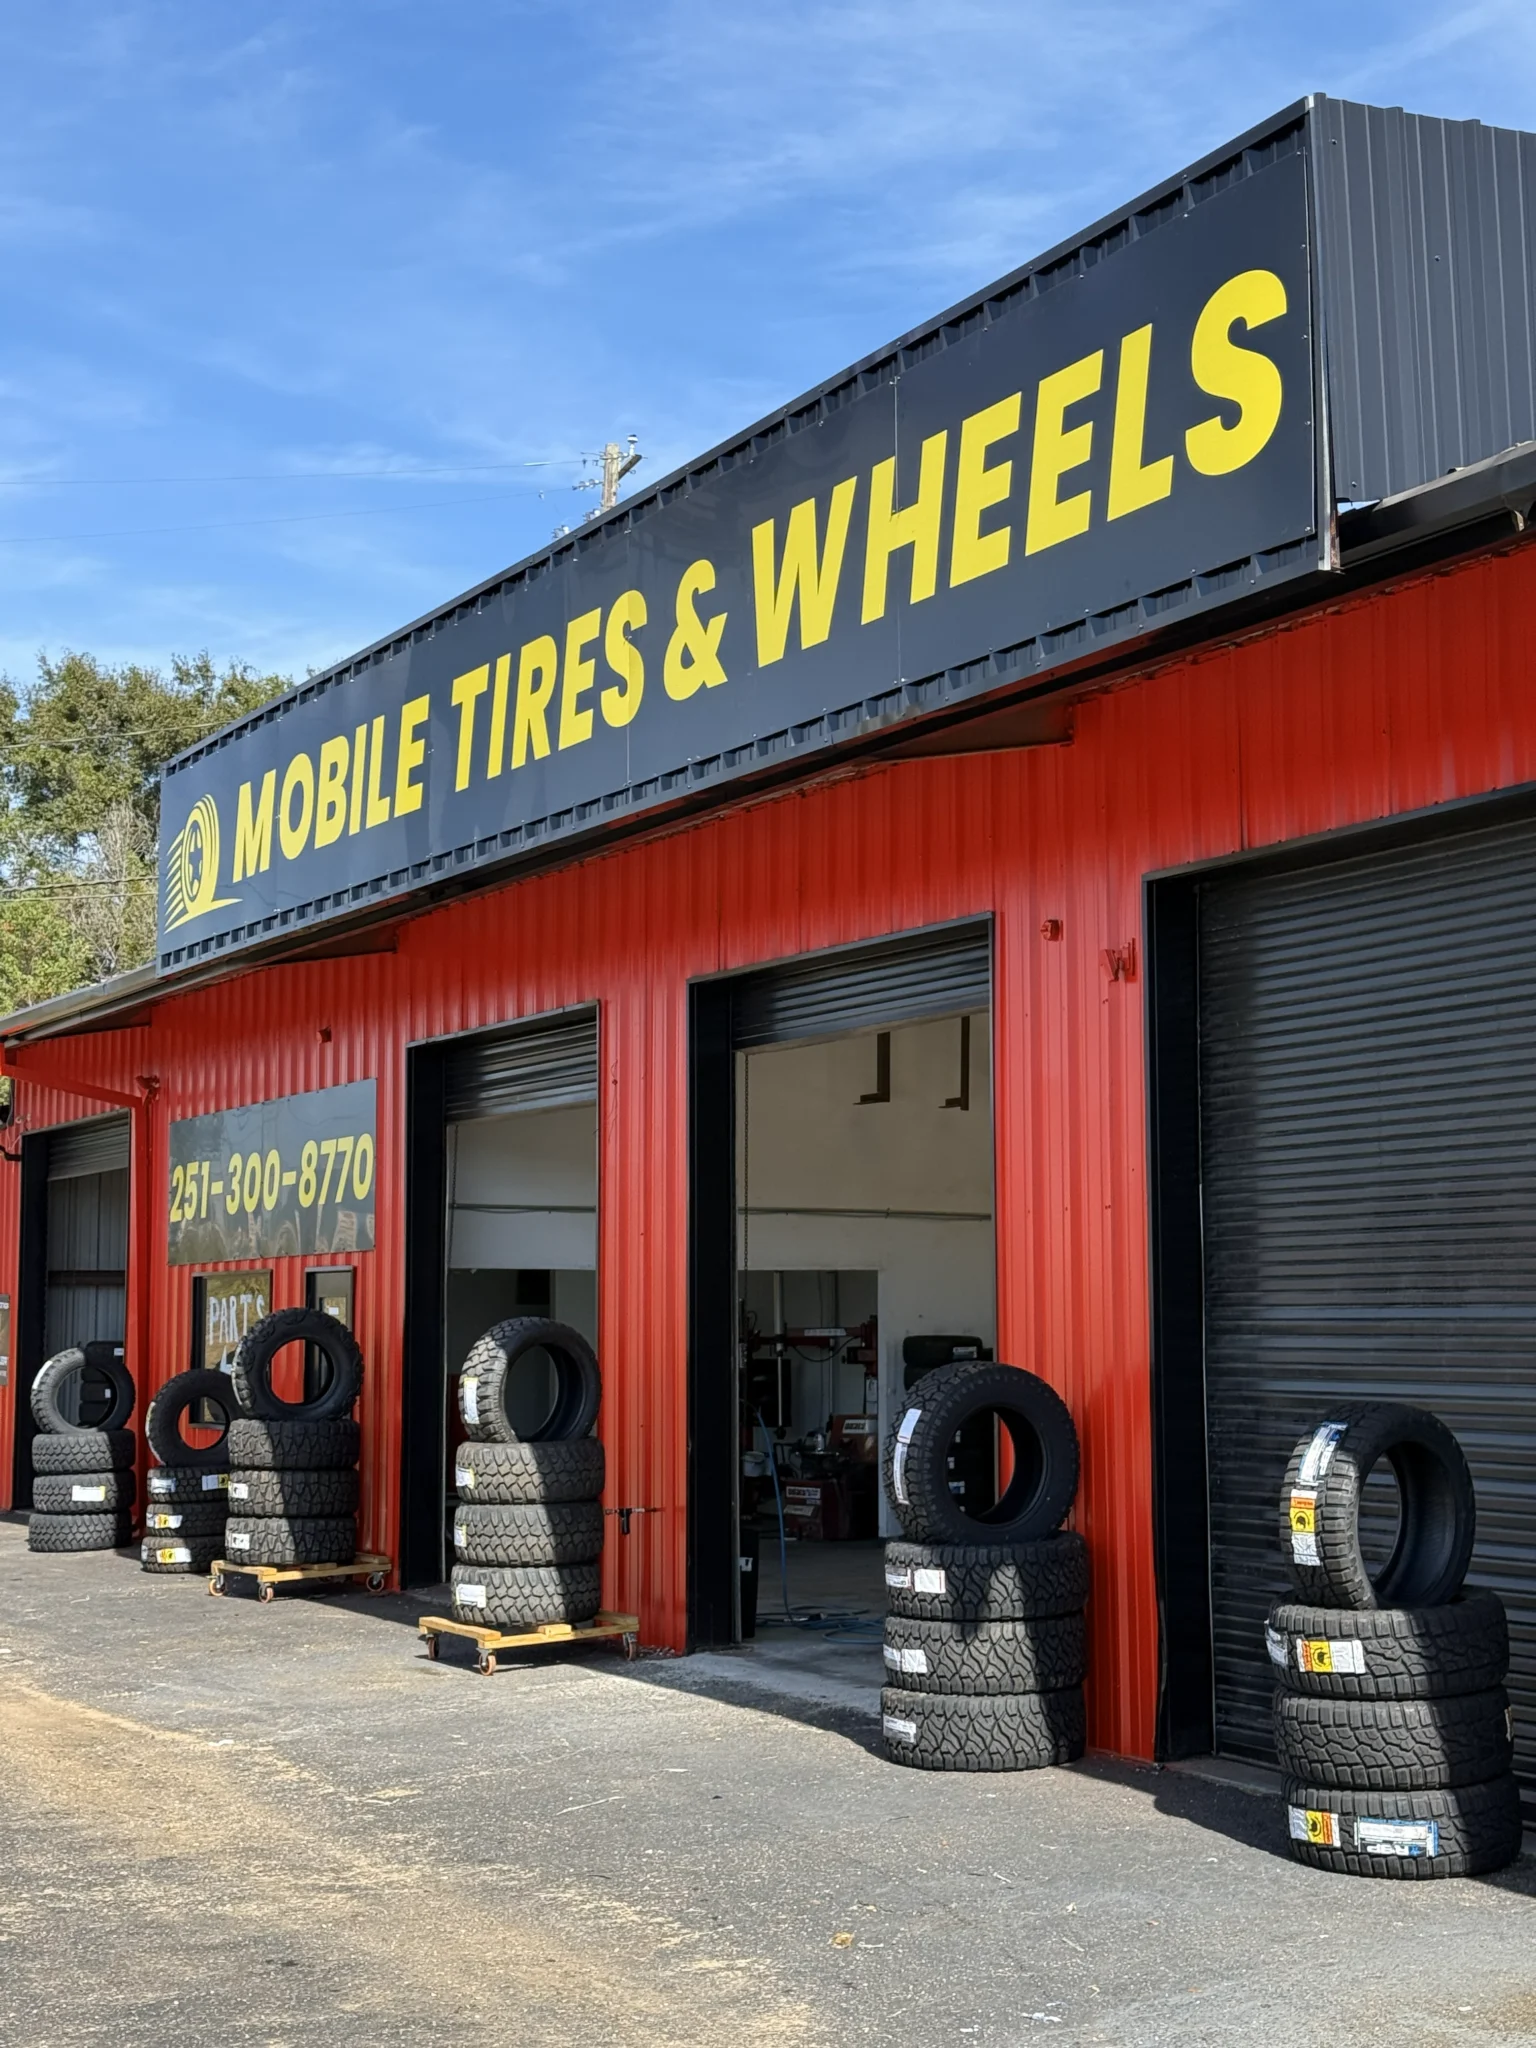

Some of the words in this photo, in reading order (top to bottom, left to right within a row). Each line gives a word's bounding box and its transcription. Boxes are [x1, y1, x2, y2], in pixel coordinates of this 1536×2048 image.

[232, 695, 430, 882] MOBILE
[450, 589, 647, 794] TIRES
[664, 560, 728, 702] &
[752, 270, 1288, 664] WHEELS
[170, 1133, 374, 1223] 251-300-8770
